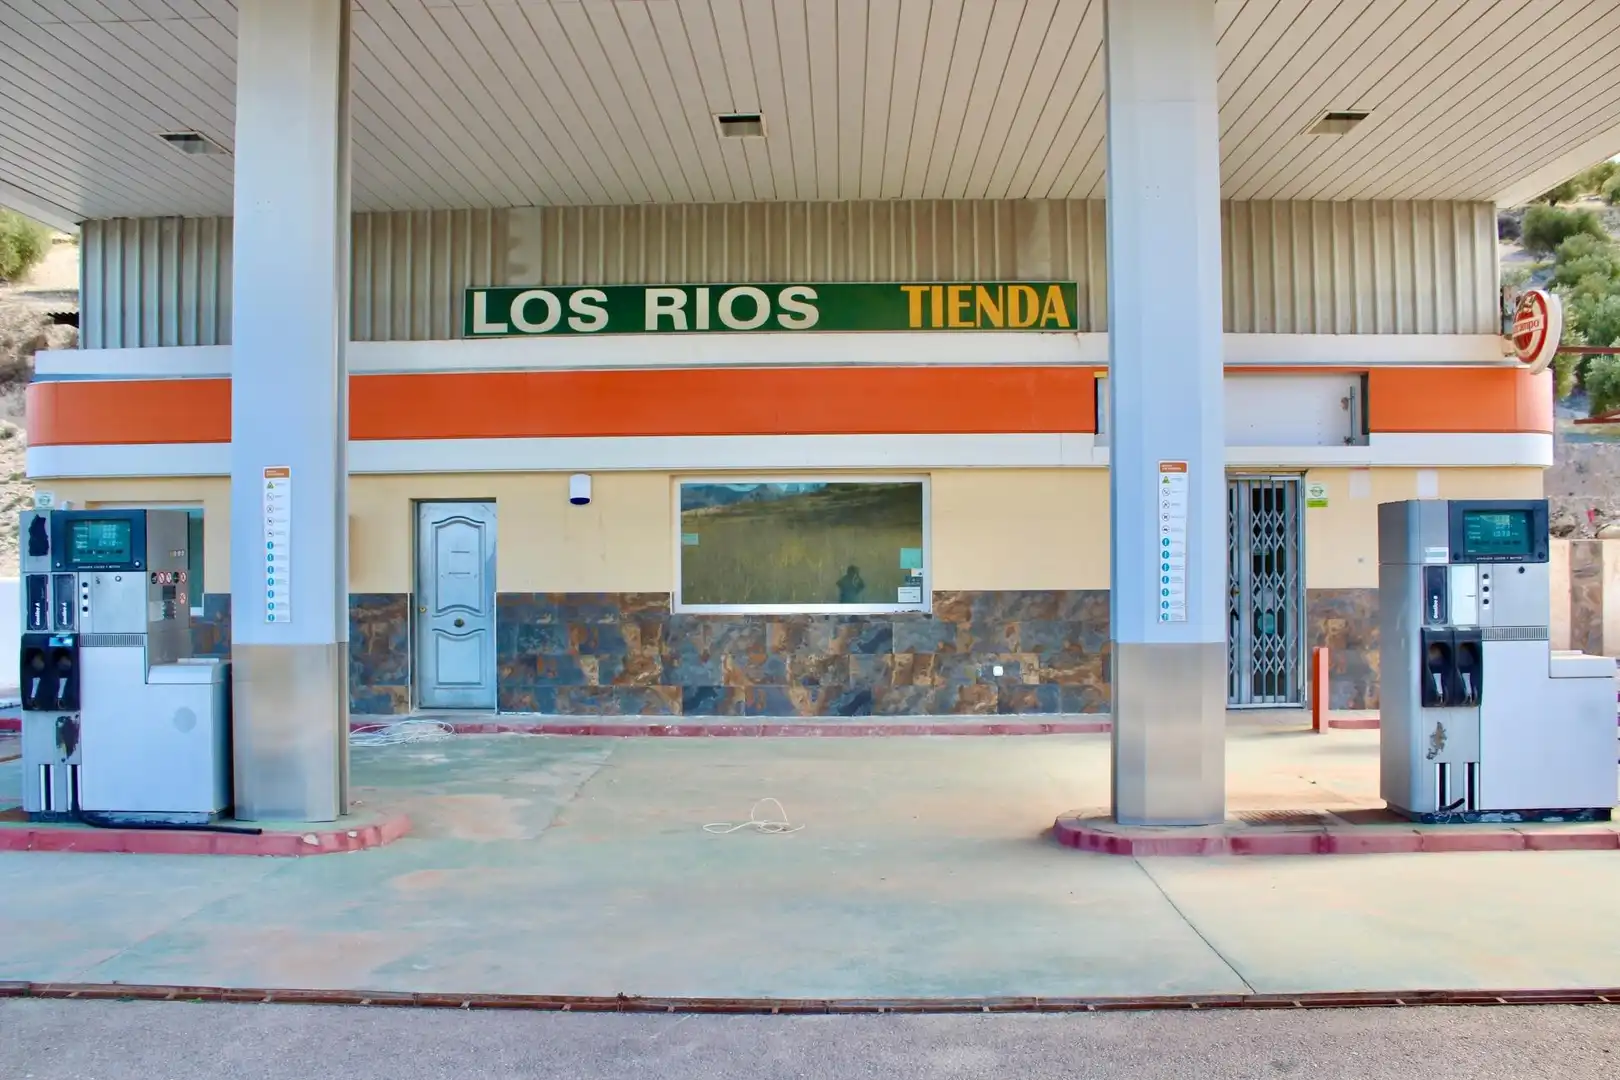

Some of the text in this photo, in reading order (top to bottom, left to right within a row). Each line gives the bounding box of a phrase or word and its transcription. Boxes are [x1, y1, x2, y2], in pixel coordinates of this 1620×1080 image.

[473, 284, 1071, 334] LOS RIOS TIENDA
